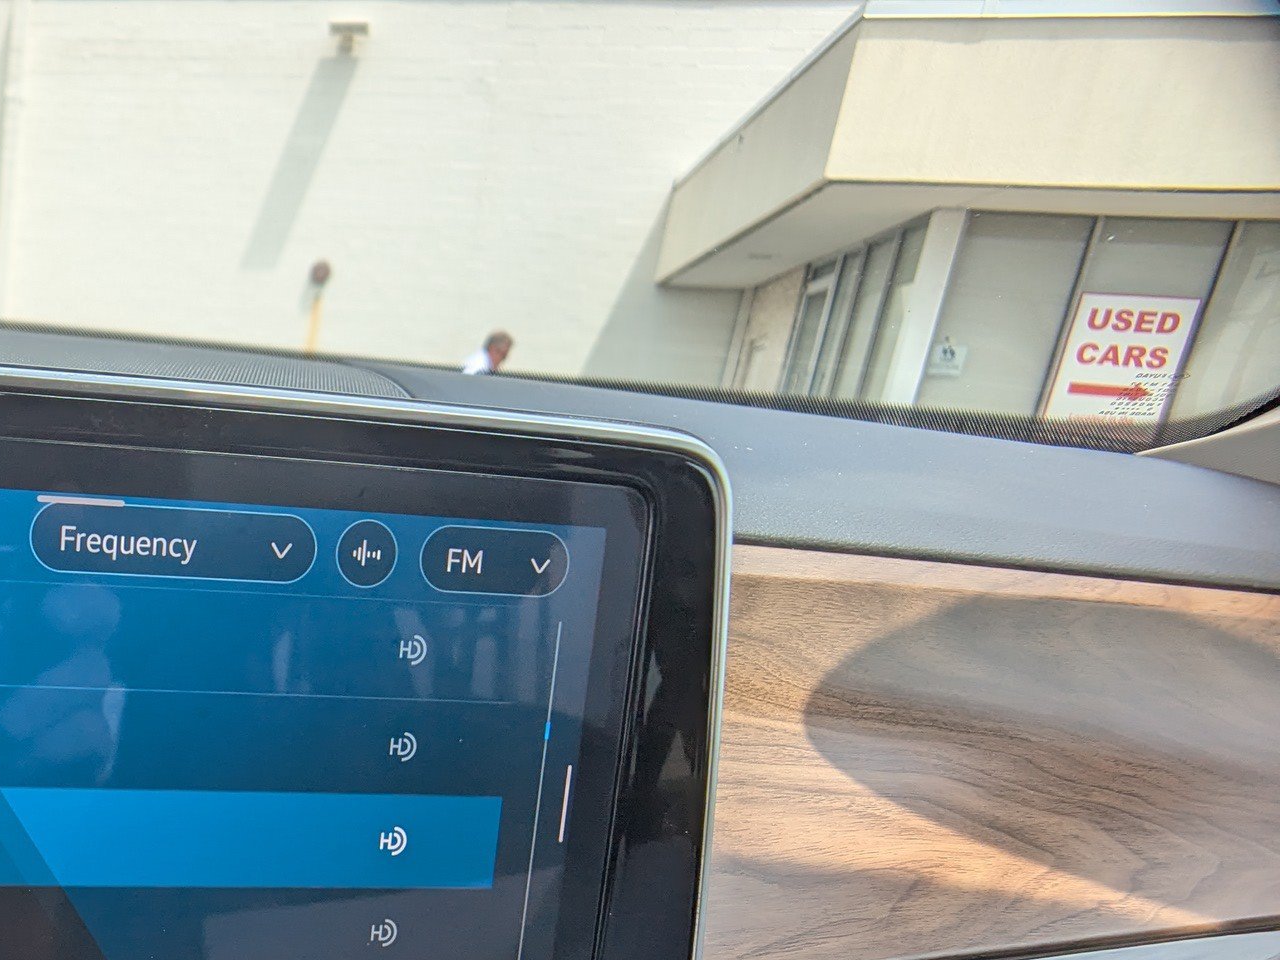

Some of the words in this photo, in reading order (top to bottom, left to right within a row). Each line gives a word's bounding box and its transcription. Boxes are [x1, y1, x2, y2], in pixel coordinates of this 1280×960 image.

[1086, 307, 1181, 334] USED
[1075, 342, 1169, 369] CARS
[59, 524, 198, 565] Frequency
[445, 547, 484, 575] FM
